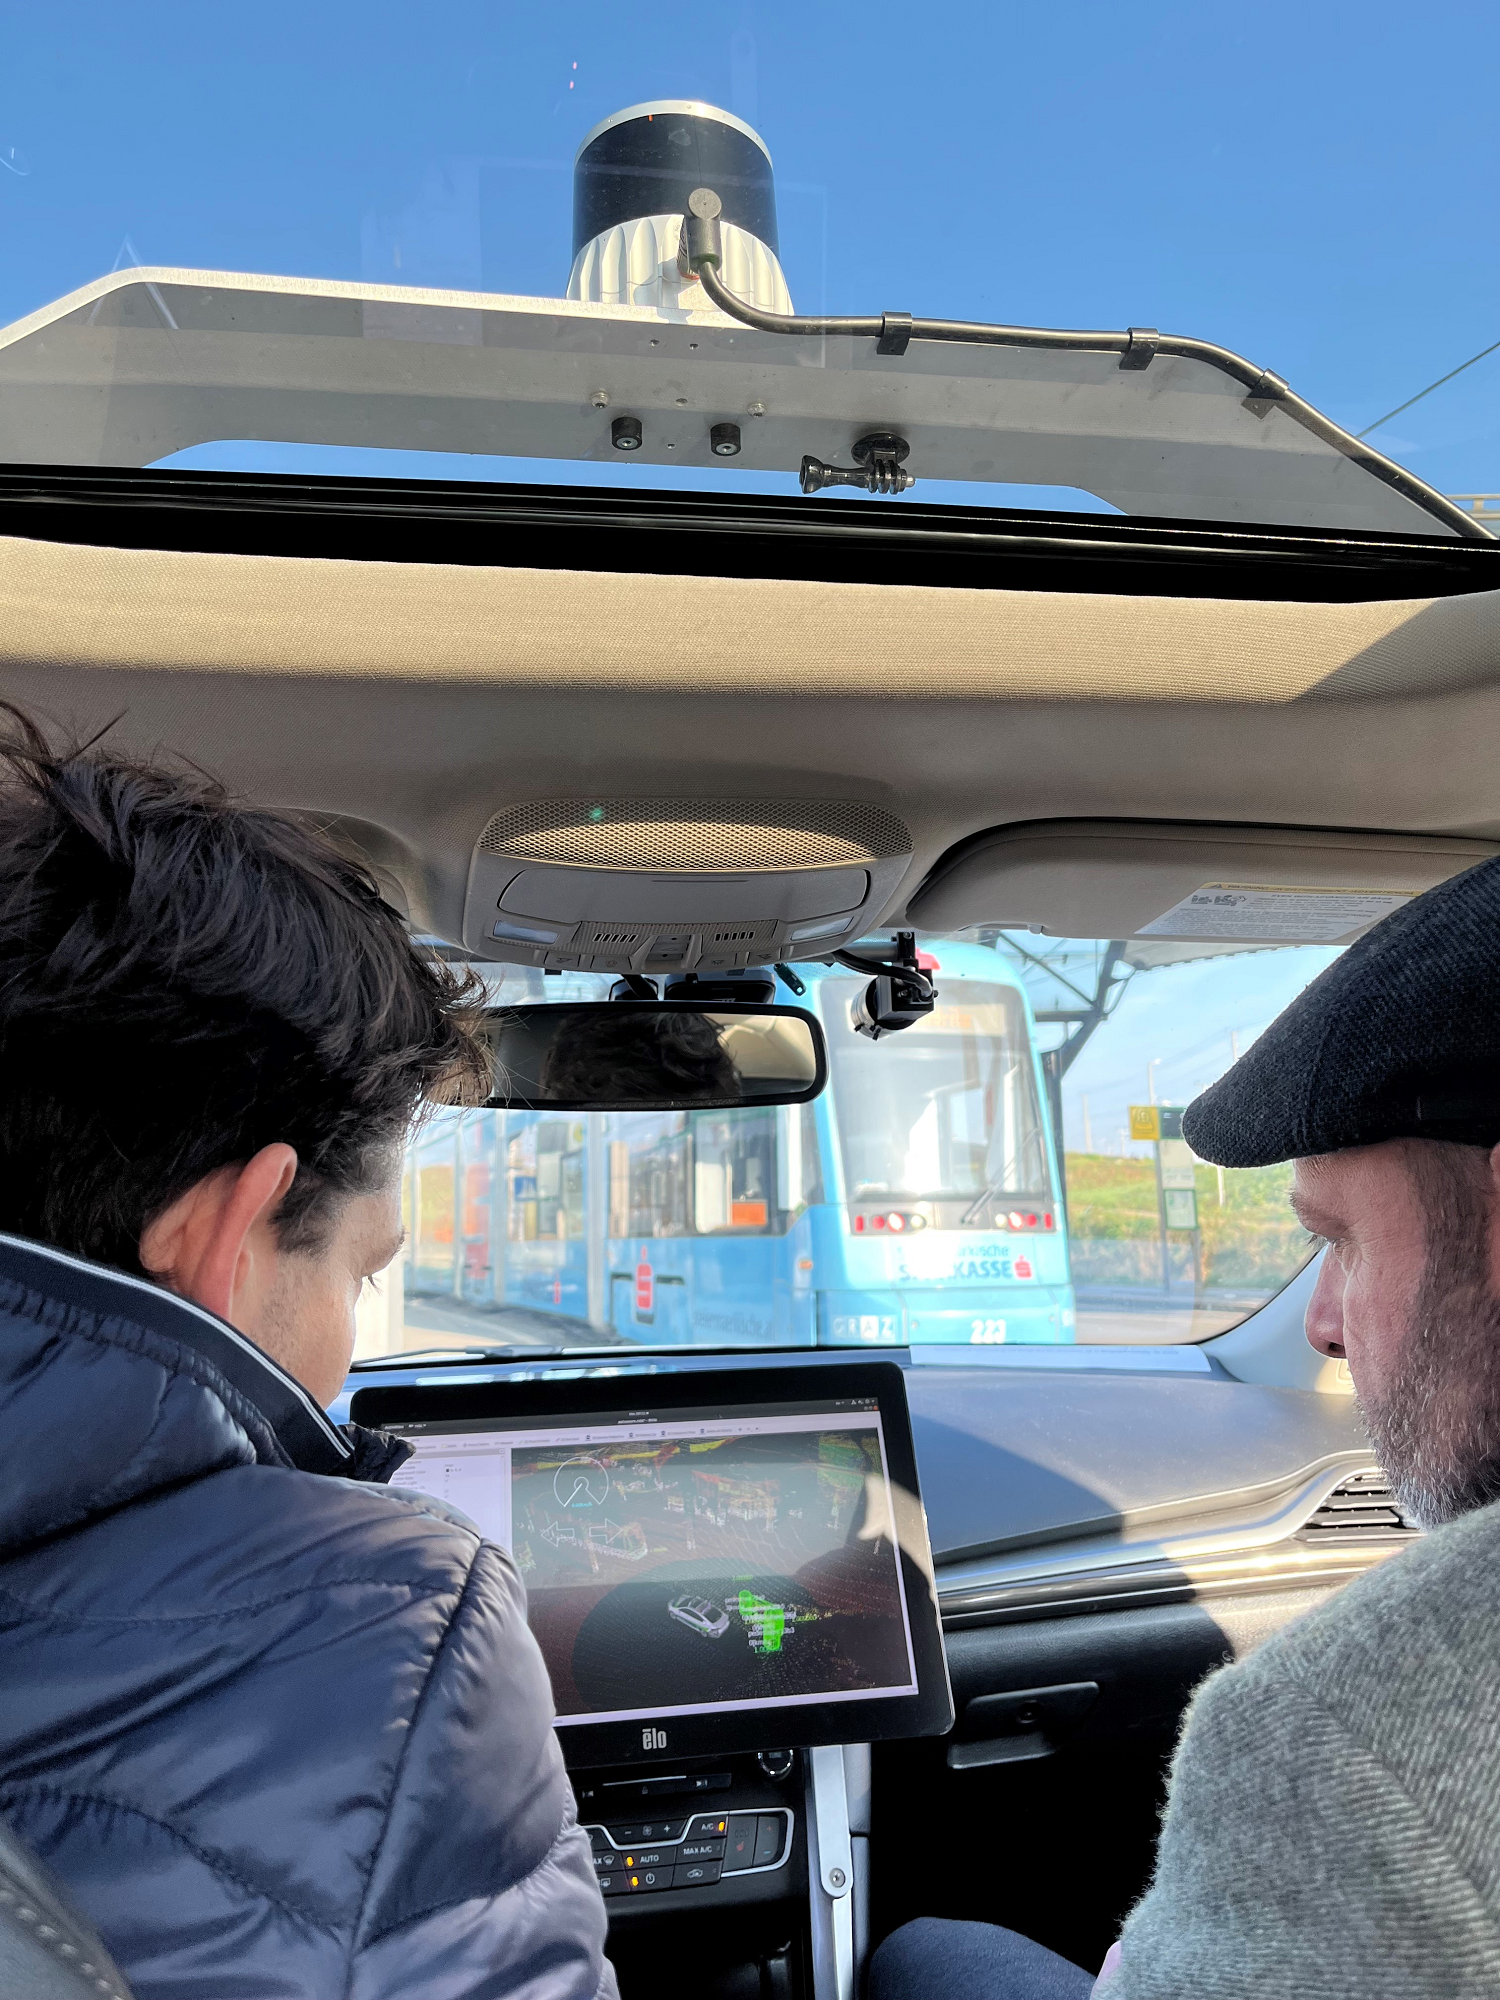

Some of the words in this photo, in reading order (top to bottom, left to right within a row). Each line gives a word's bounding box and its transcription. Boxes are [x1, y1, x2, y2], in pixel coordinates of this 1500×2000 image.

[899, 1260, 1012, 1281] SKASSE
[683, 1846, 699, 1855] MAX
[699, 1845, 713, 1854] A/C
[639, 1854, 660, 1863] AUTO
